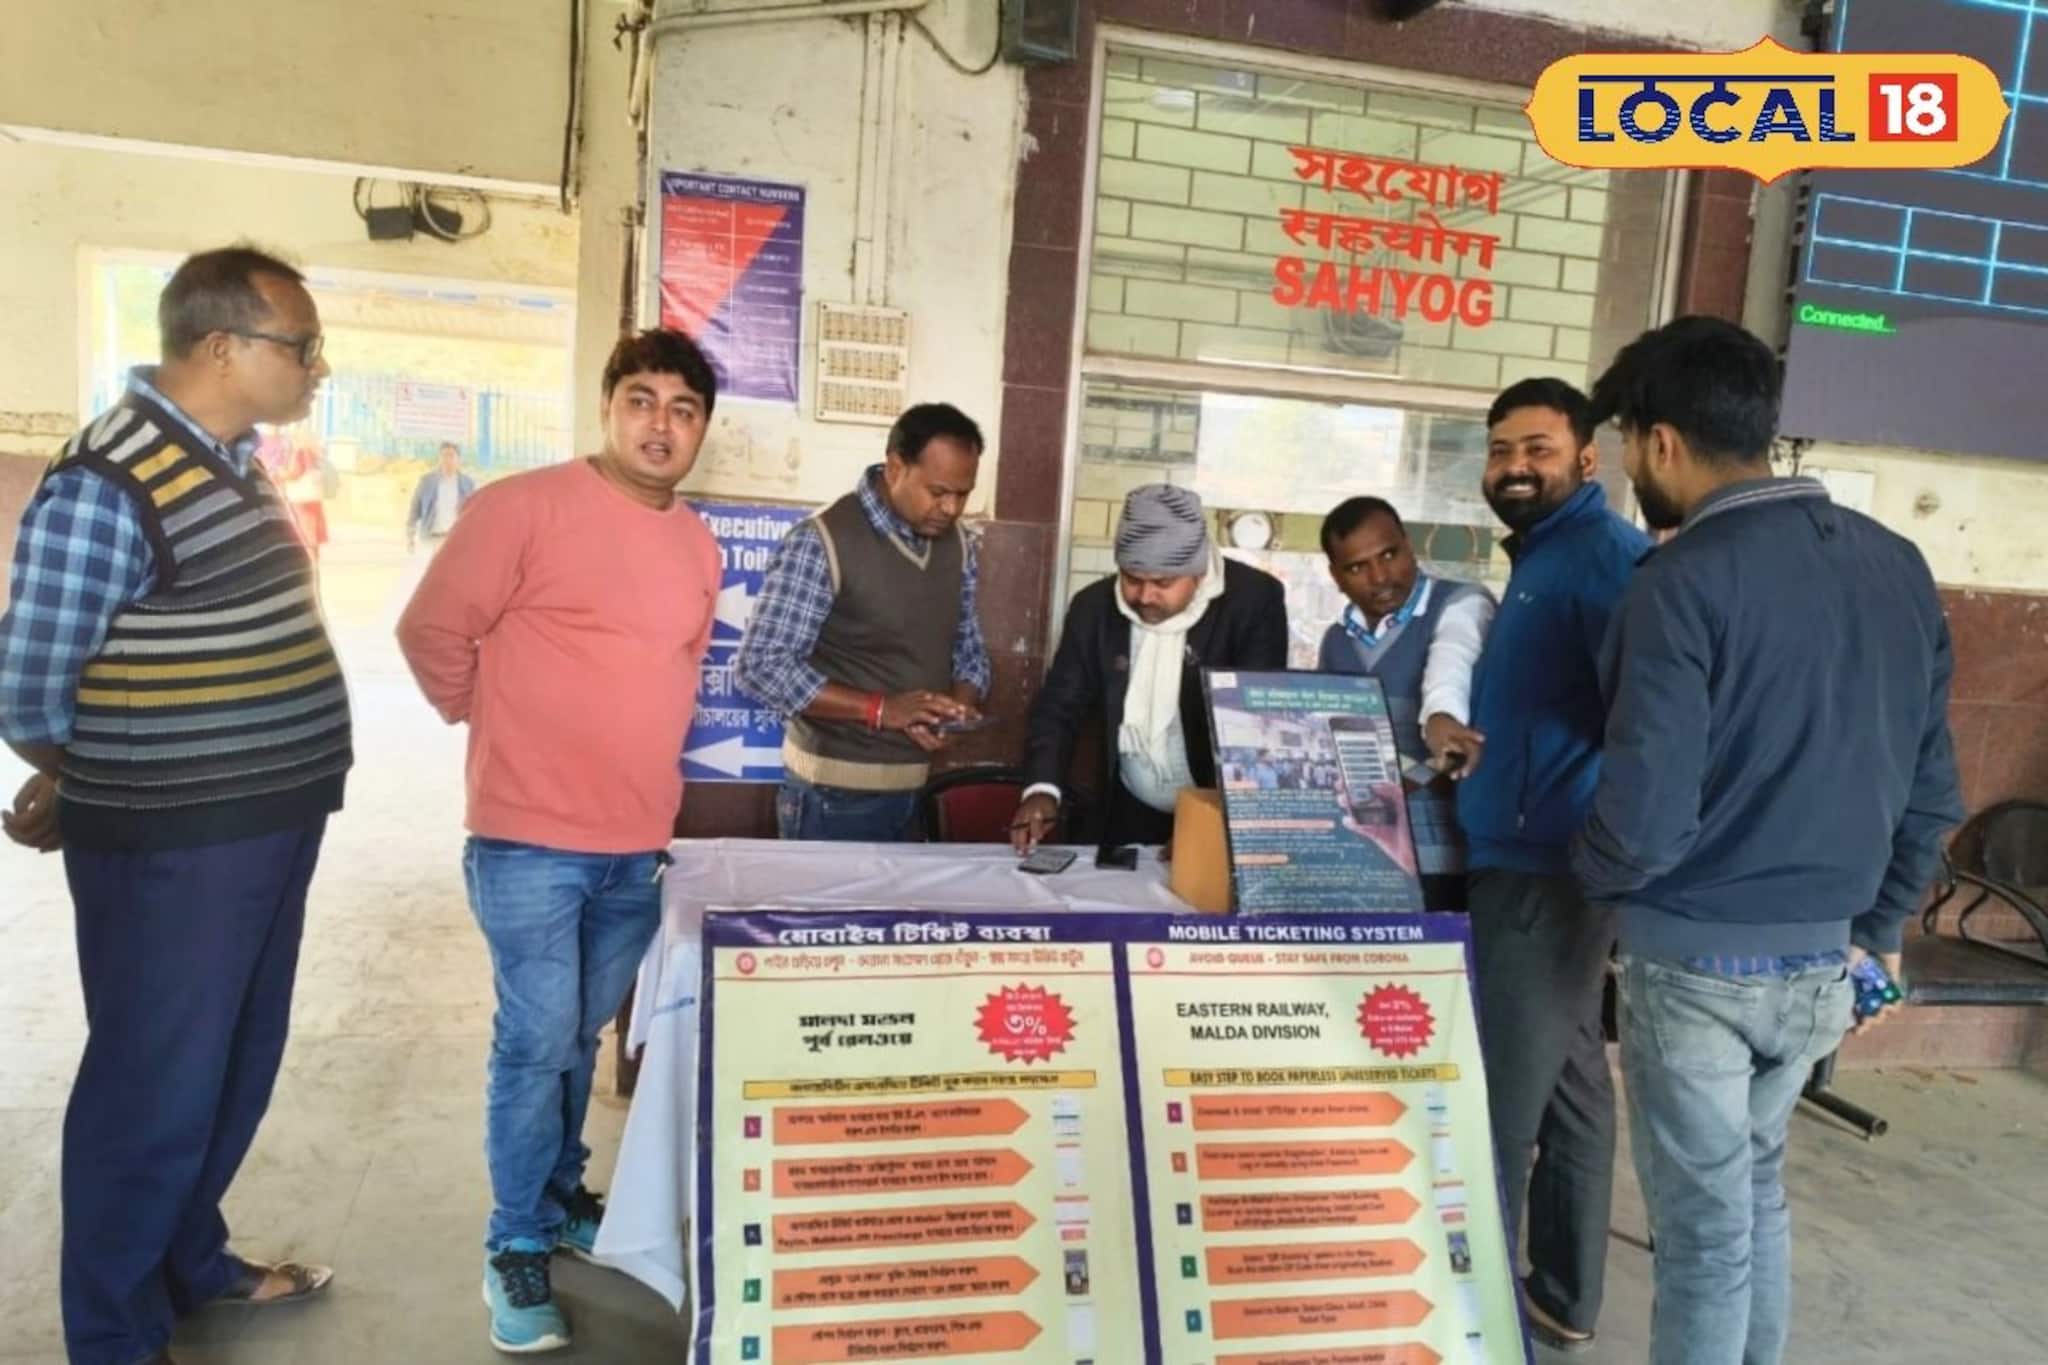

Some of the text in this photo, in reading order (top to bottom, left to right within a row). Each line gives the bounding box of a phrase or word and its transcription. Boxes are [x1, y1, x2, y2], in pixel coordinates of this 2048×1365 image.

[1286, 145, 1505, 216] সহযোগ
[1279, 207, 1501, 271] सहयोग
[1272, 256, 1494, 328] SAHYOG
[893, 921, 970, 943] টিকিট
[1168, 925, 1424, 940] MOBILE TICKETING SYSTEM
[1176, 1001, 1330, 1019] EASTERN RAILWAY,
[1190, 1024, 1321, 1040] MALDA DIVISION
